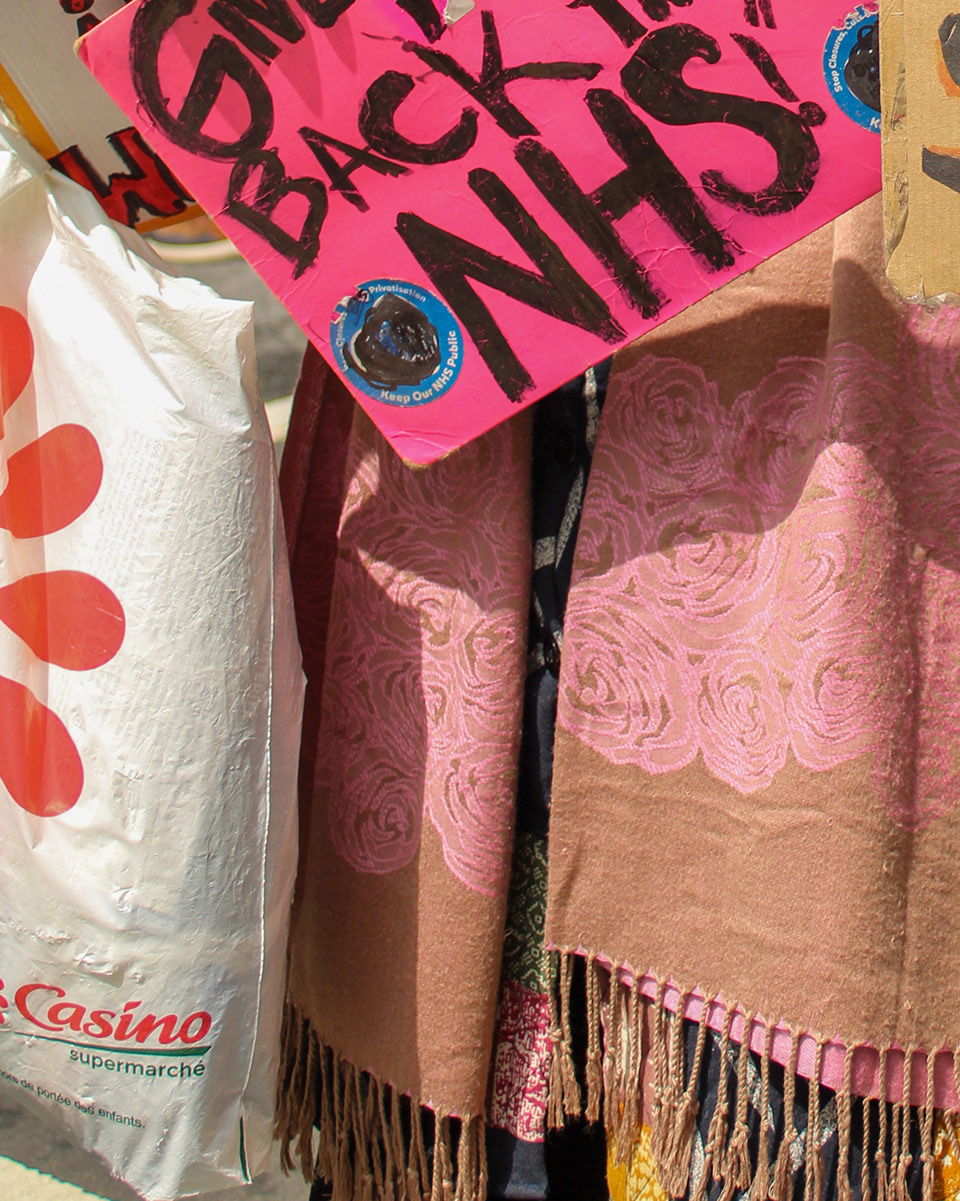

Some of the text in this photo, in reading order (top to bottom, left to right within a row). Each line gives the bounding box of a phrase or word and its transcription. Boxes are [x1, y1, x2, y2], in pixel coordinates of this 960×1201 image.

[828, 30, 848, 69] Closures,
[831, 71, 843, 93] Stop
[222, 10, 604, 280] BACK
[368, 284, 427, 303] Privatisation
[380, 330, 459, 405] Keep Our NHS Public
[14, 982, 213, 1045] Casino
[69, 1048, 206, 1079] supermarché
[20, 1078, 35, 1091] de
[37, 1086, 72, 1106] portée
[98, 1108, 147, 1129] enfants.
